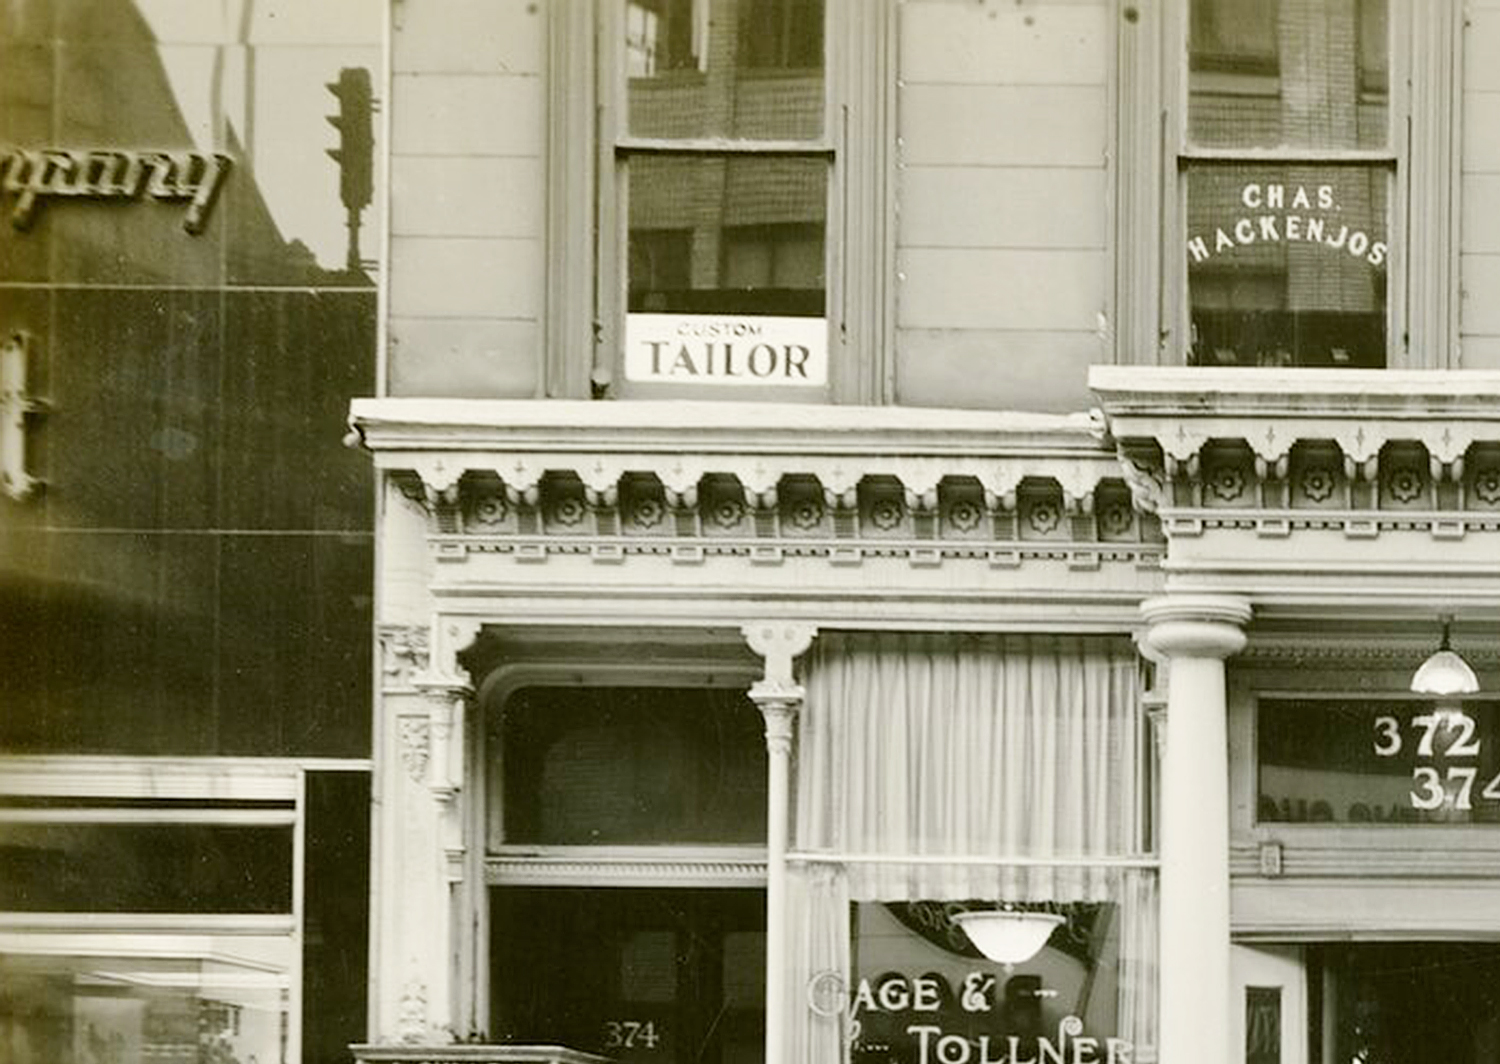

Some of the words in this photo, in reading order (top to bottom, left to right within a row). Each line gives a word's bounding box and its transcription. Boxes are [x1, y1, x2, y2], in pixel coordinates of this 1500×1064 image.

[1242, 184, 1341, 211] CHAS.
[1187, 215, 1388, 264] HACKENJOS
[677, 321, 762, 337] CUSTOM
[640, 340, 810, 378] TAILOR
[1373, 714, 1481, 757] 372
[806, 969, 942, 1036] GAGE
[962, 971, 996, 1013] &
[605, 1021, 659, 1049] 374
